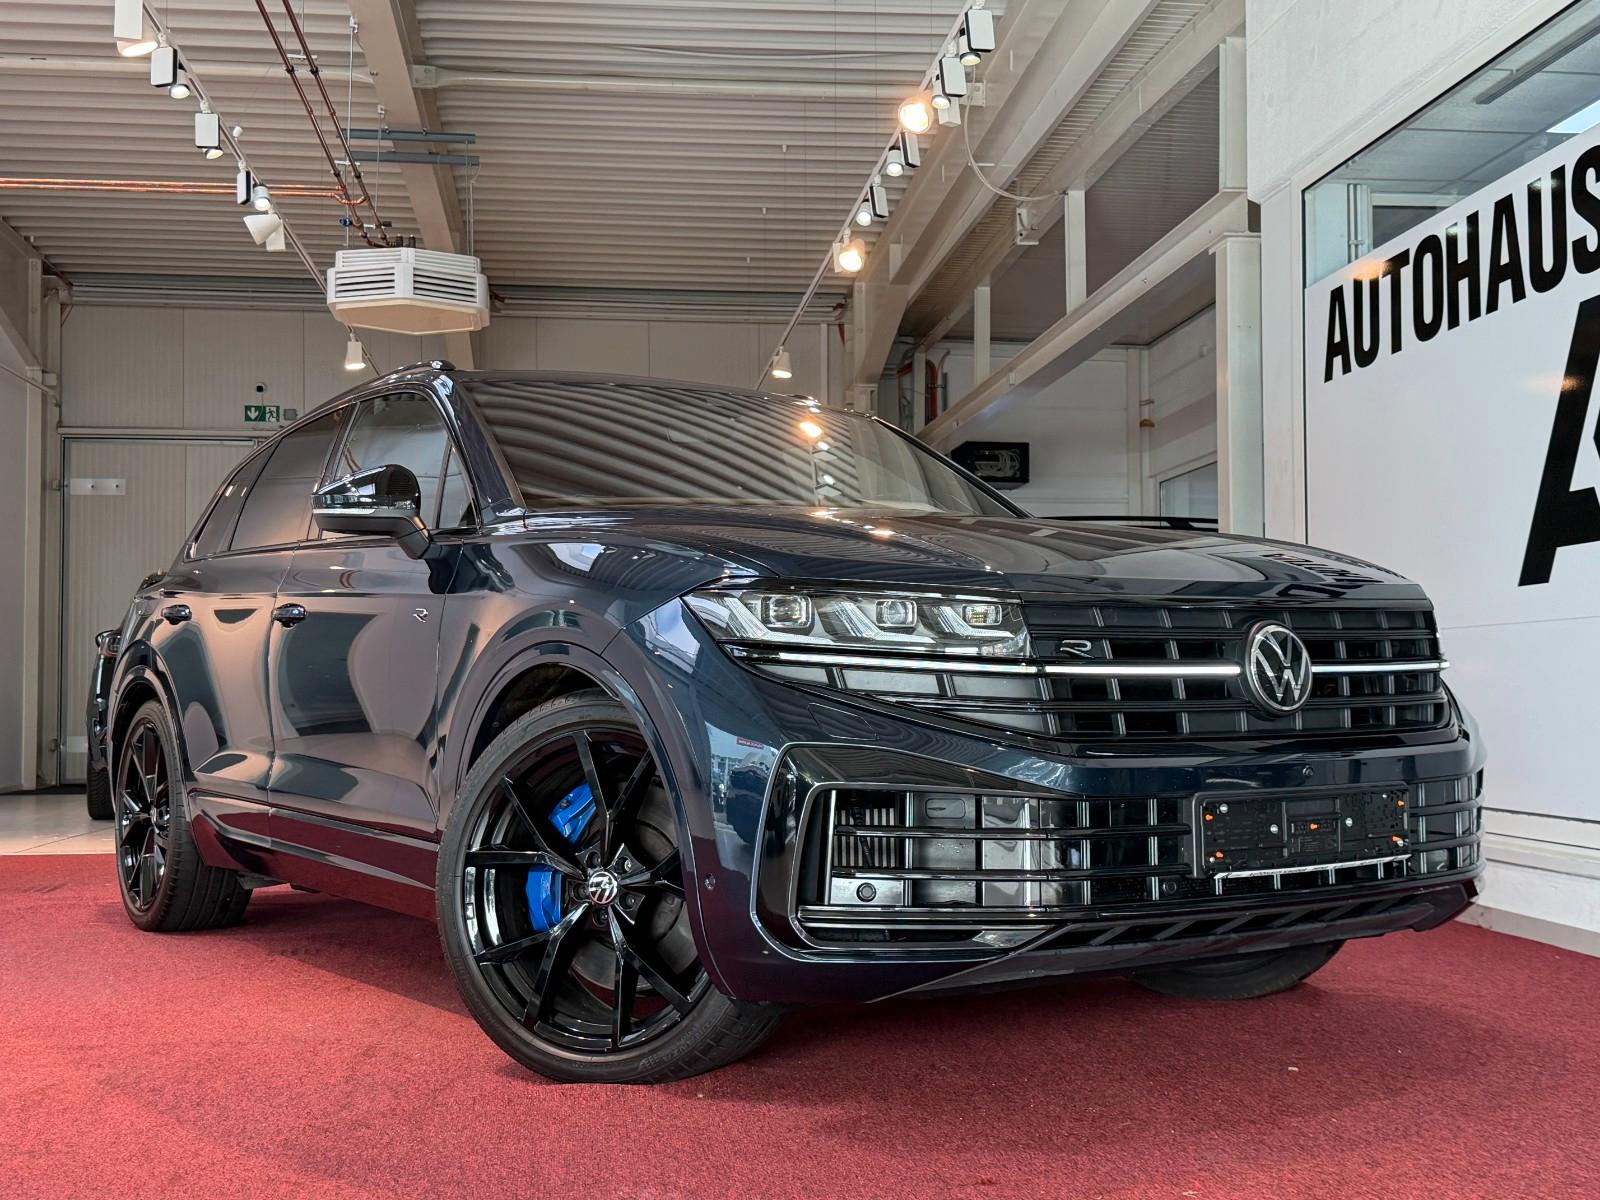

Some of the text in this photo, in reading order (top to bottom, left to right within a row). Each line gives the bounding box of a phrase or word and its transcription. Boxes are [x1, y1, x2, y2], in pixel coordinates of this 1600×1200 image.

[1324, 145, 1600, 383] AUTOHAUS
[1060, 639, 1094, 658] R
[1251, 625, 1311, 710] VW
